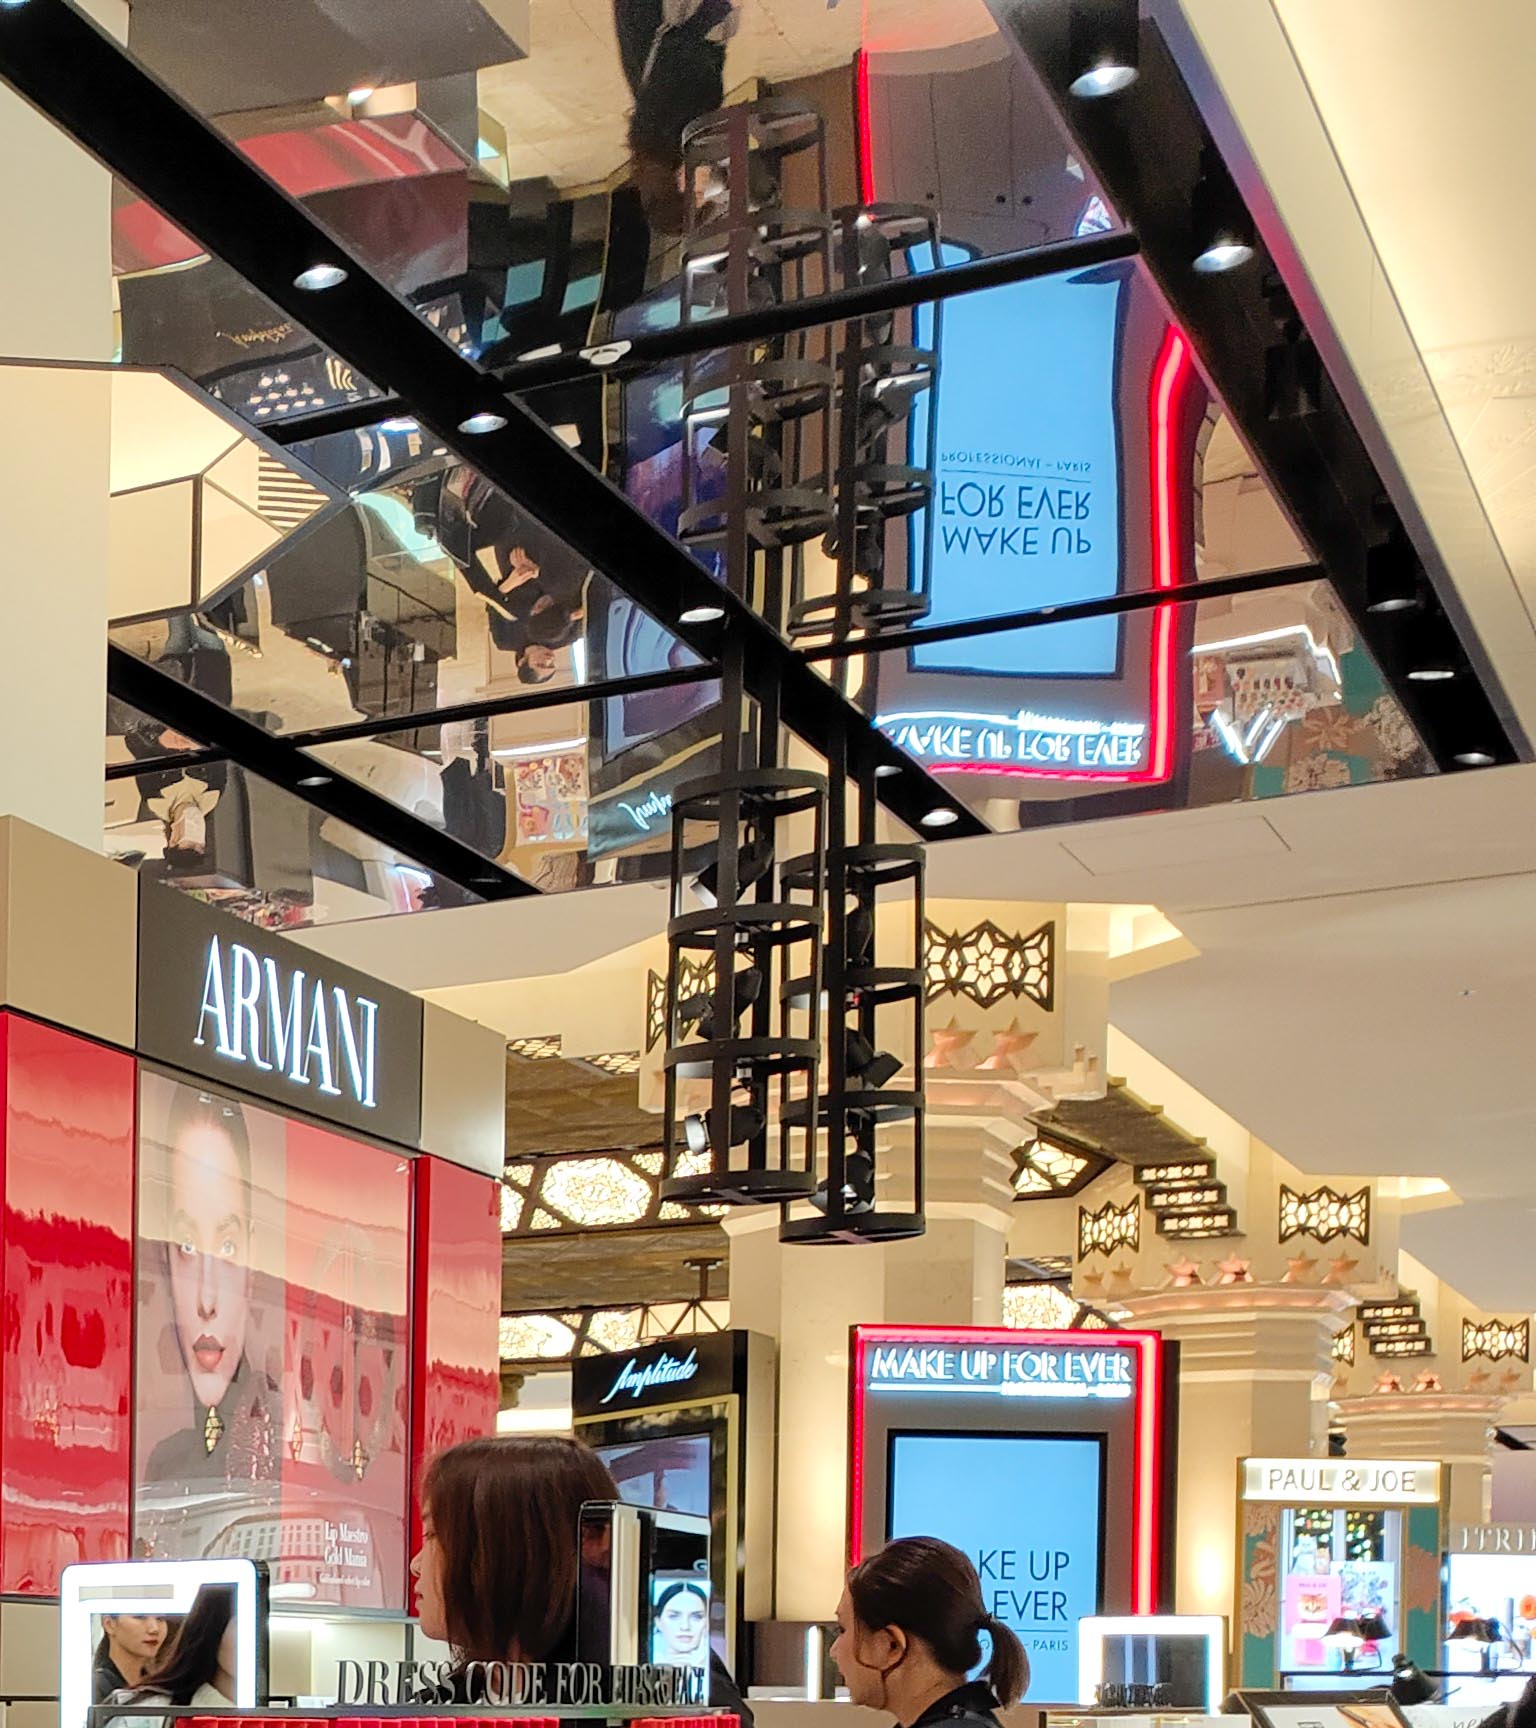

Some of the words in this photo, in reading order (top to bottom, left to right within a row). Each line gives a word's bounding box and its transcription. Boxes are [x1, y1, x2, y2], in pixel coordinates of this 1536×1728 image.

[193, 933, 379, 1107] ARMANI
[599, 1346, 699, 1404] Amplitude
[871, 1347, 954, 1380] MAKE
[959, 1349, 999, 1381] UP
[1002, 1350, 1059, 1381] FOR
[1063, 1351, 1133, 1383] EVER
[1269, 1468, 1333, 1491] PAUL
[1341, 1469, 1361, 1492] &
[1369, 1470, 1417, 1493] JOE
[1460, 1526, 1536, 1551] ITRI
[979, 1549, 1016, 1580] KE
[1029, 1550, 1070, 1581] UP
[993, 1590, 1068, 1621] EVER
[1033, 1639, 1069, 1652] PARIS
[336, 1659, 457, 1706] DRESS
[465, 1659, 548, 1706] CODE
[555, 1661, 604, 1706] FOR
